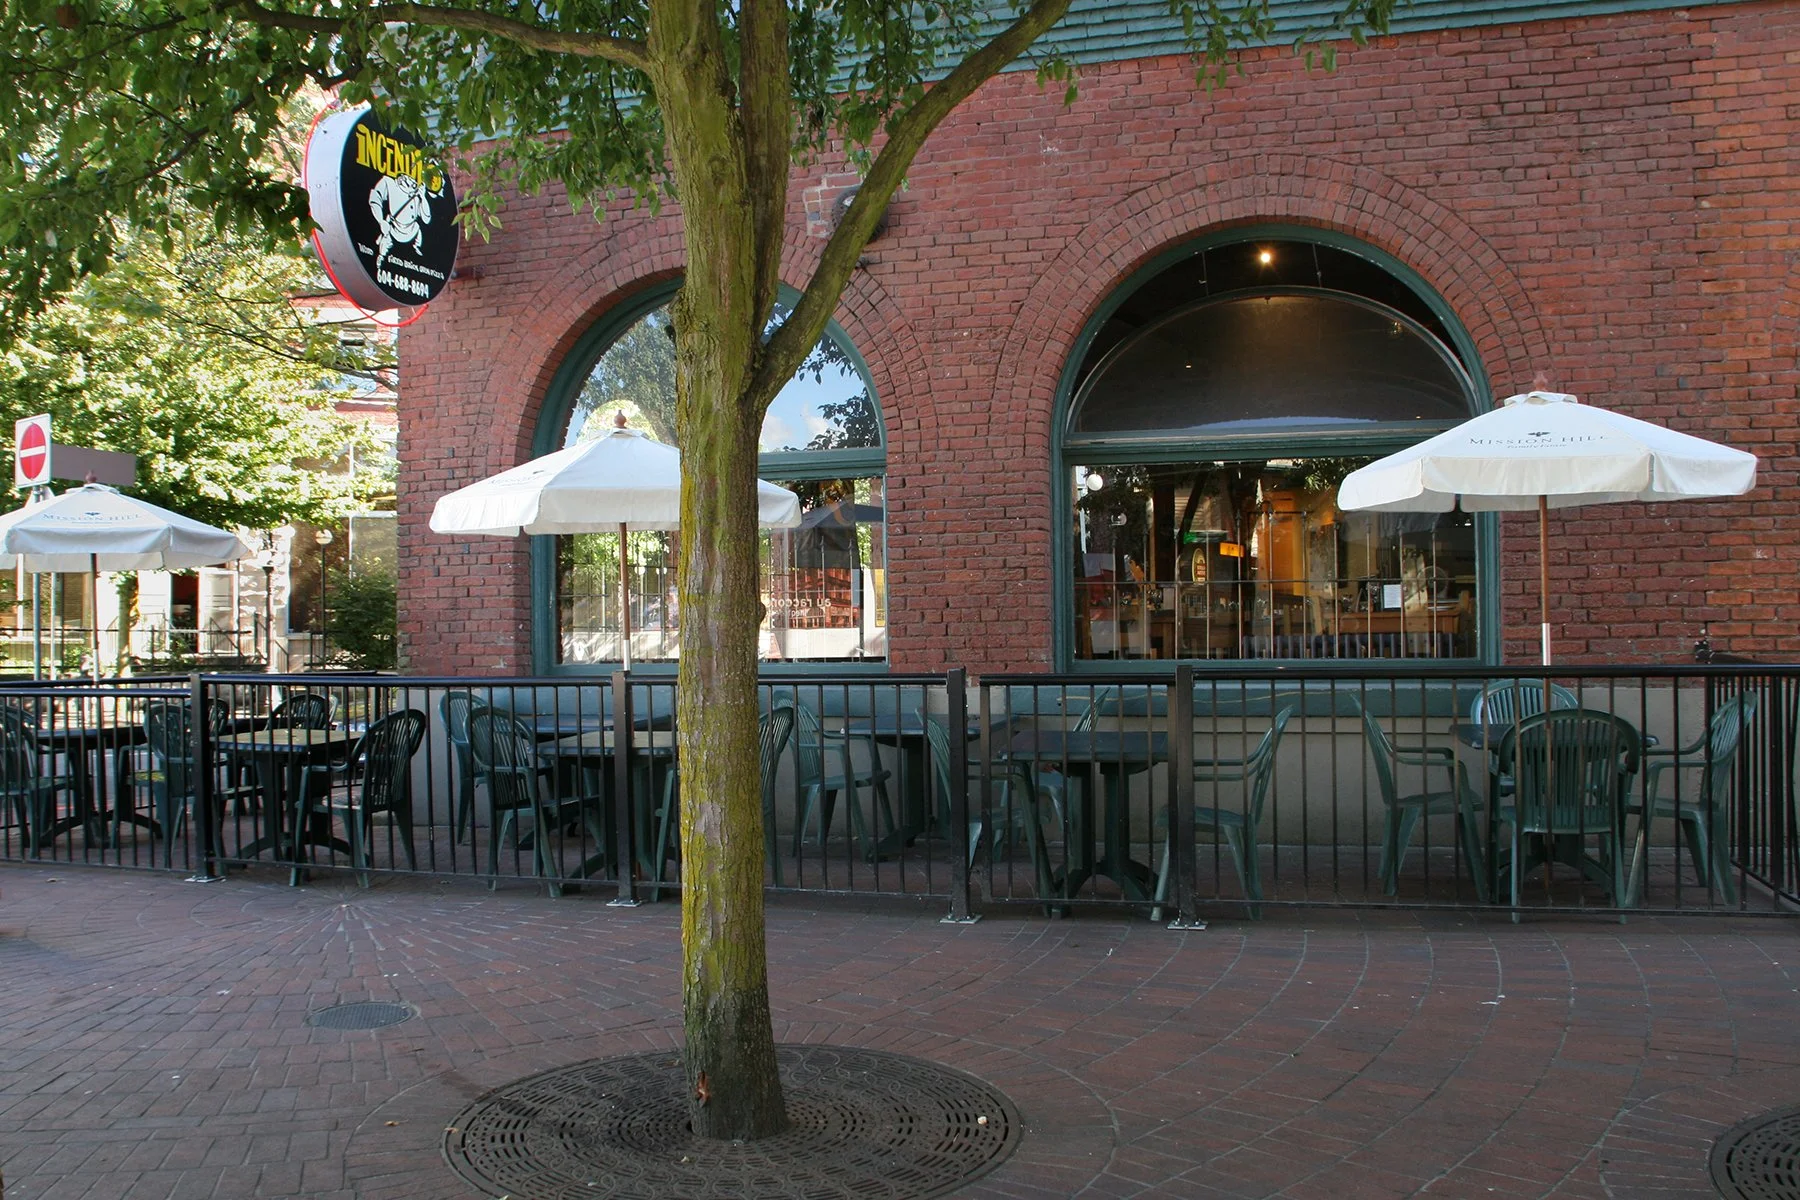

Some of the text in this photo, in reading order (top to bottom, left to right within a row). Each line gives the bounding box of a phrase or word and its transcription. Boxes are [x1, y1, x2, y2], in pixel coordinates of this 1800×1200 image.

[377, 268, 429, 299] 604-688-8694
[1469, 435, 1608, 445] MISSION HILL
[42, 513, 140, 521] MISSION HILL
